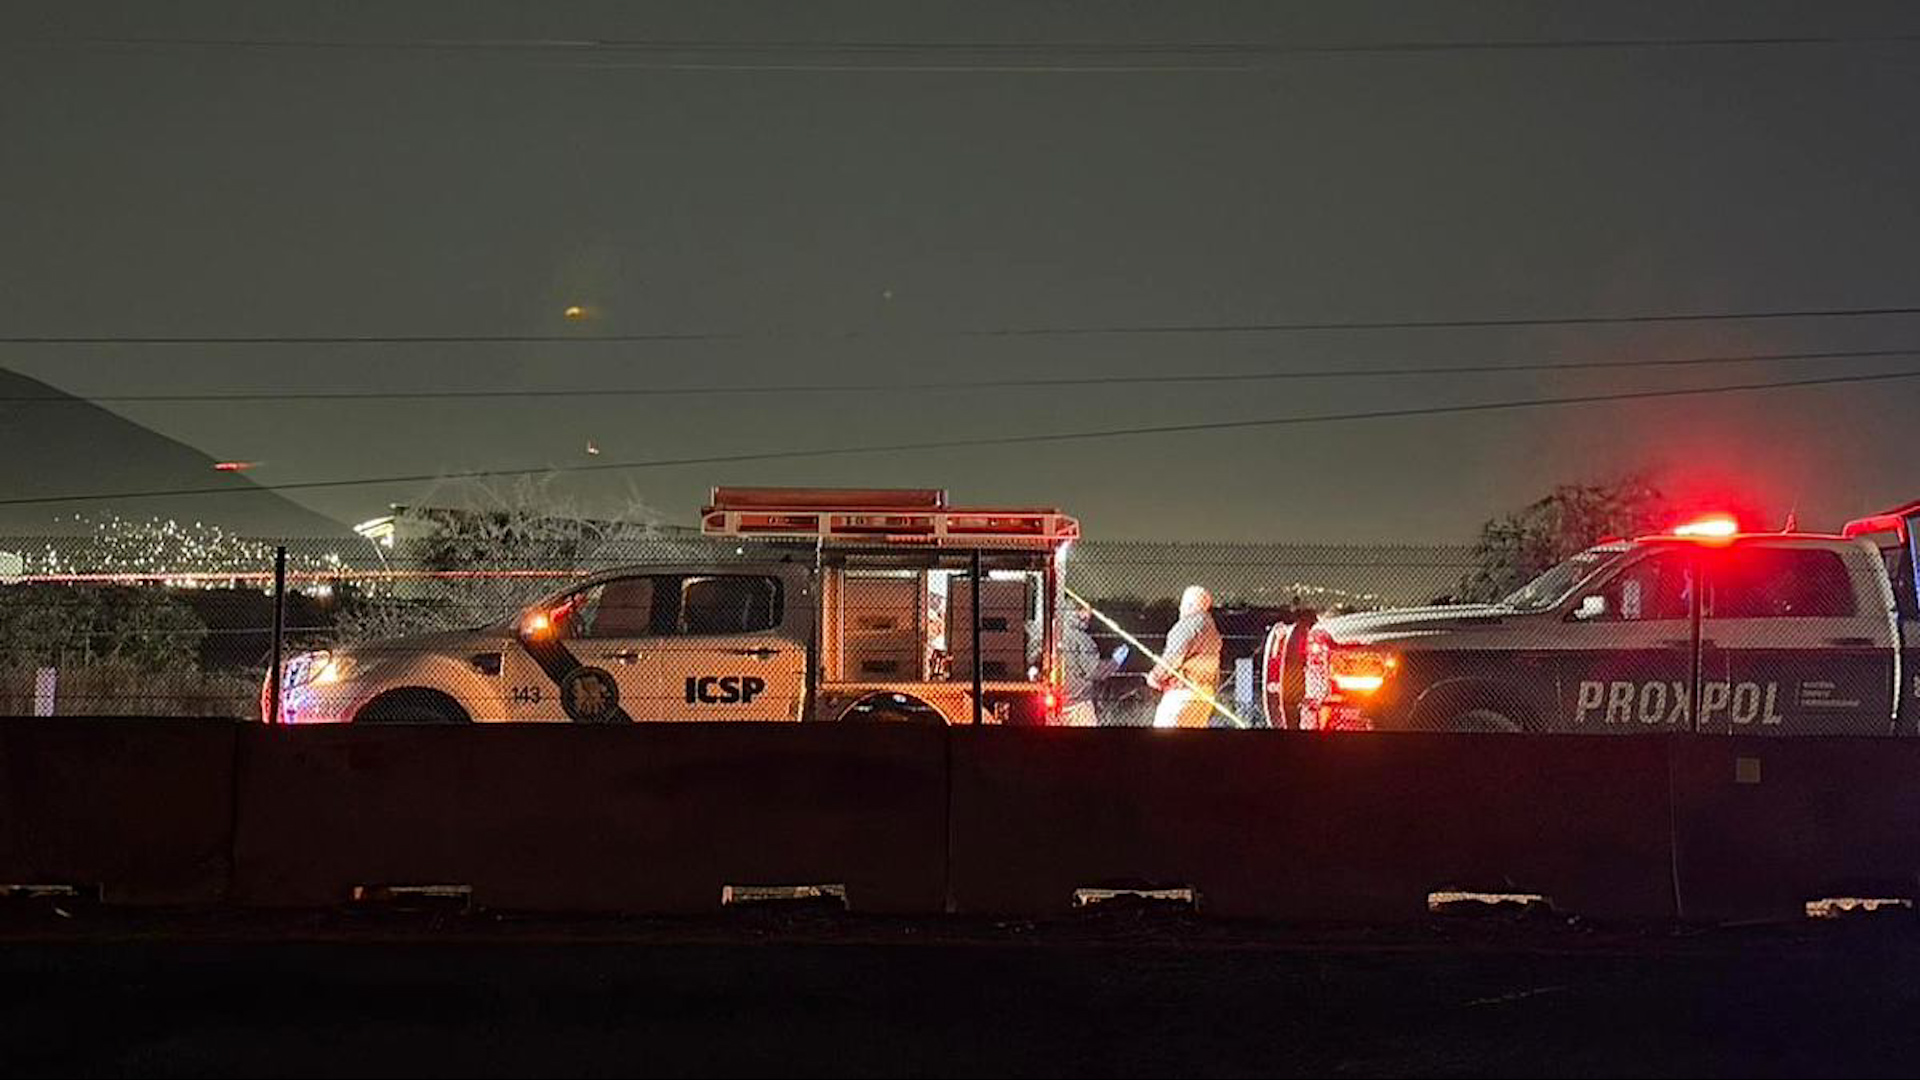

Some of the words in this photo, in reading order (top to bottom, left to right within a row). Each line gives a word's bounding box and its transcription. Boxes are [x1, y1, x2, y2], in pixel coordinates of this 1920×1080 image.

[512, 686, 541, 703] 143
[685, 677, 765, 704] ICSP
[1576, 681, 1782, 724] PROXPOL
